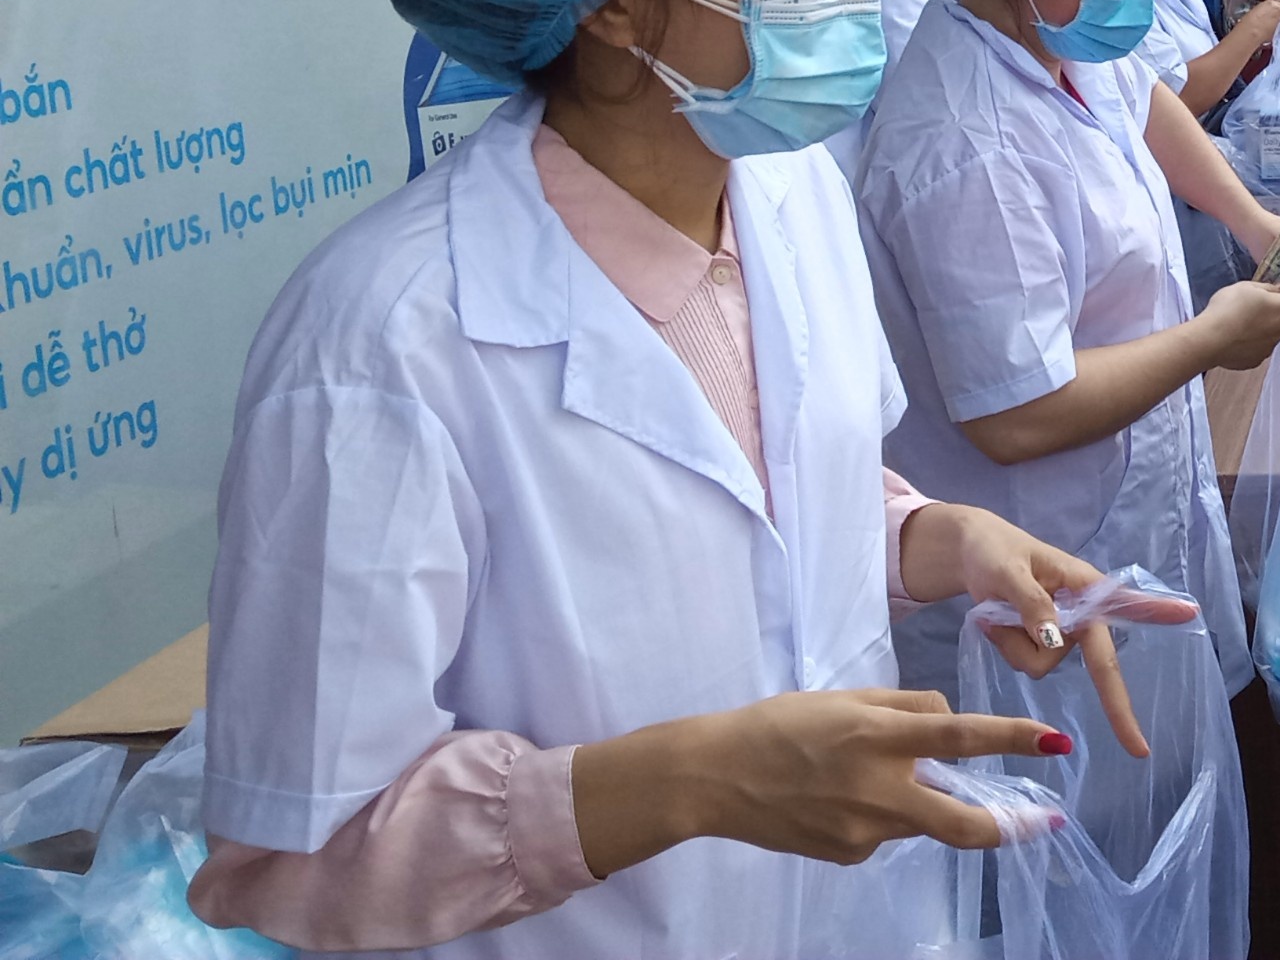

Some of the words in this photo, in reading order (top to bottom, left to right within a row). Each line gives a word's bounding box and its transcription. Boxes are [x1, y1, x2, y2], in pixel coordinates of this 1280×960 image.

[0, 63, 72, 126] bắn
[64, 135, 146, 199] chất
[154, 121, 246, 174] lượng
[0, 234, 113, 313] huẩn,
[122, 213, 211, 266] virus,
[219, 192, 265, 240] lọc
[270, 166, 315, 219] bụi
[322, 153, 372, 200] mịn
[22, 330, 72, 398] dễ
[82, 306, 147, 373] thở
[0, 456, 26, 516] y
[41, 424, 78, 482] dị
[87, 400, 158, 458] ứng
